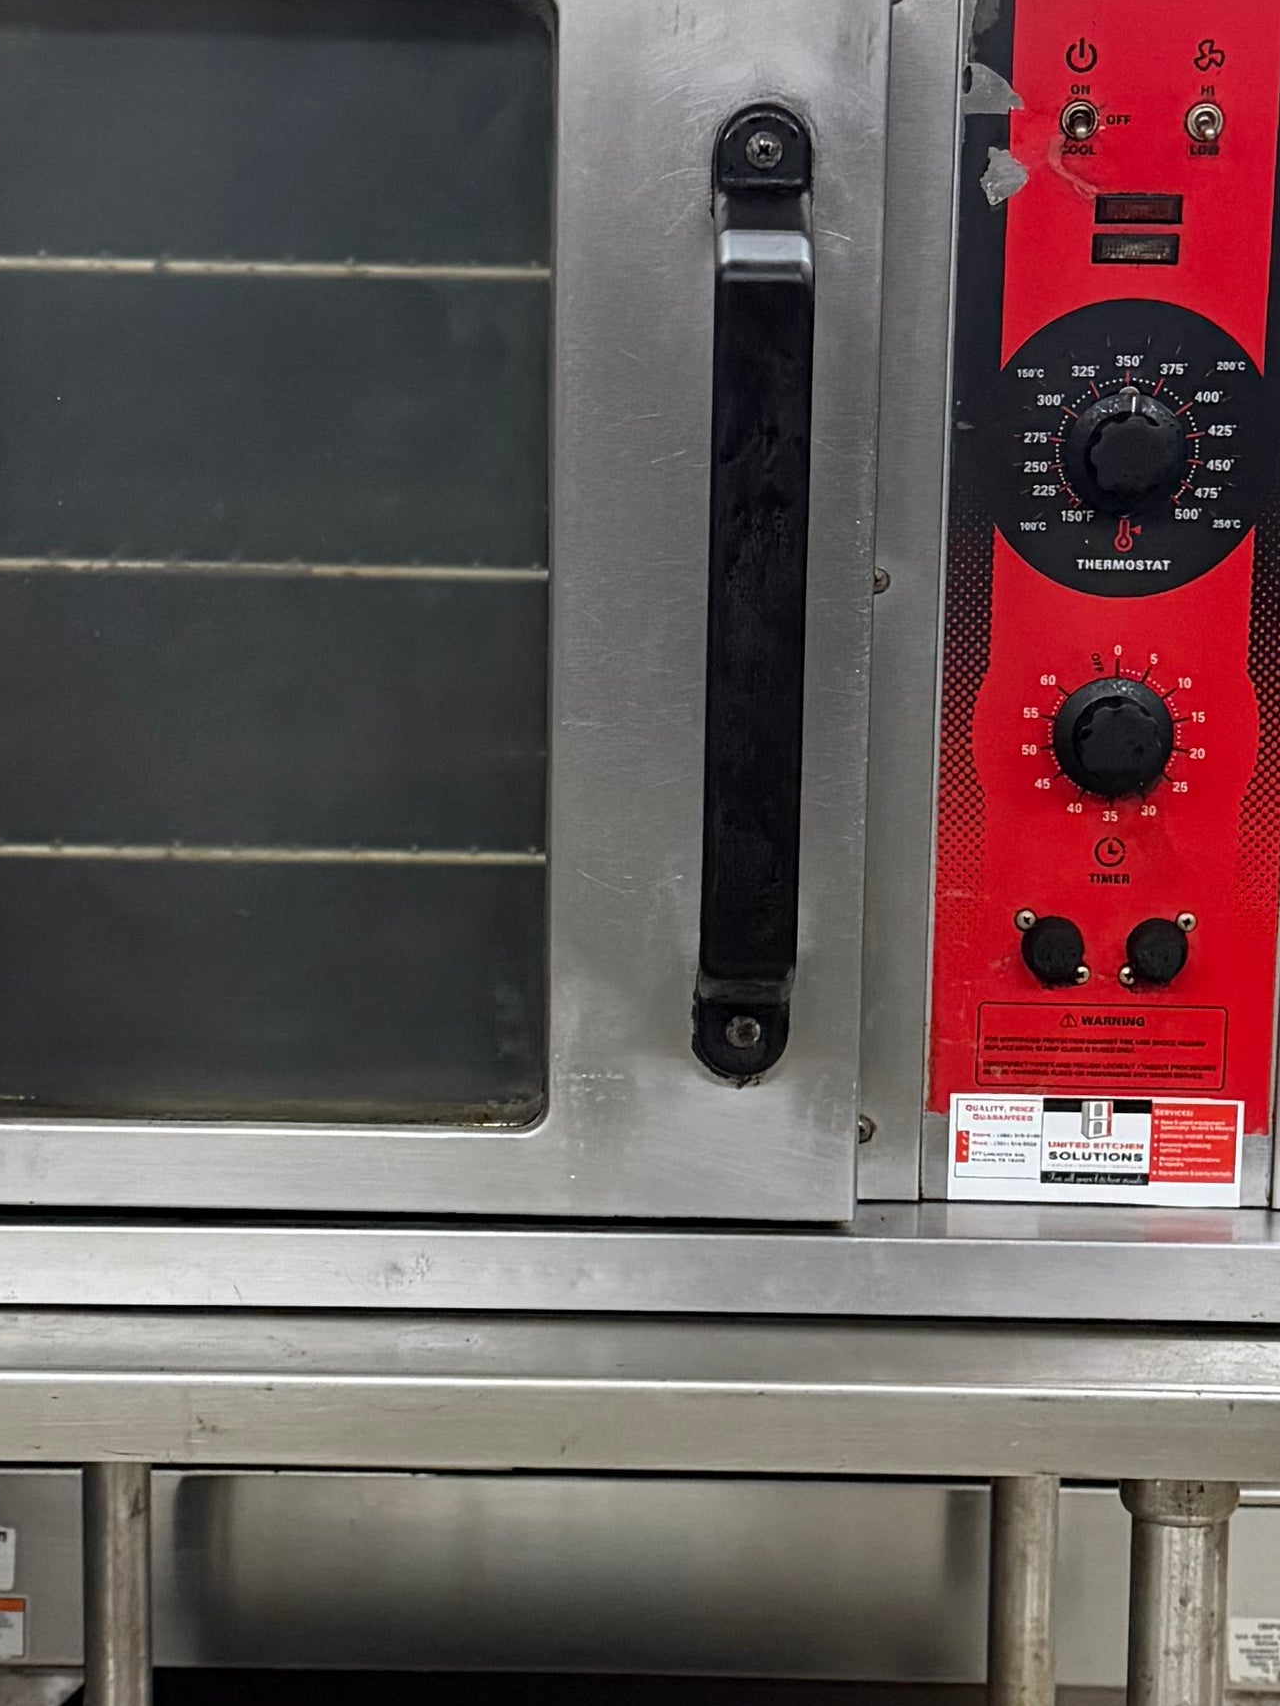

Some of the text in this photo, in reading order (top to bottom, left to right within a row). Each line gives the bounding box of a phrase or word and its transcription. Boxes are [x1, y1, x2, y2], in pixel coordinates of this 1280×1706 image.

[1071, 85, 1090, 95] ON
[1106, 115, 1131, 125] OFF
[1076, 558, 1171, 571] THERMOSTAT
[1114, 645, 1122, 655] 0
[1150, 654, 1158, 665] 5
[1040, 674, 1056, 686] 60
[1177, 677, 1192, 689] 10
[1023, 707, 1039, 719] 55
[1191, 711, 1205, 723] 15
[1021, 744, 1037, 755] 50
[1189, 748, 1205, 760] 20
[1034, 778, 1050, 789] 45
[1172, 781, 1188, 793] 25
[1067, 803, 1082, 814] 40
[1141, 805, 1156, 816] 30
[1102, 811, 1118, 822] 35
[1088, 873, 1130, 885] TIMER
[1081, 1016, 1145, 1028] WARNING
[1048, 1141, 1144, 1150] UNITED KITCHEN
[1048, 1151, 1143, 1162] SOLUTIONS
